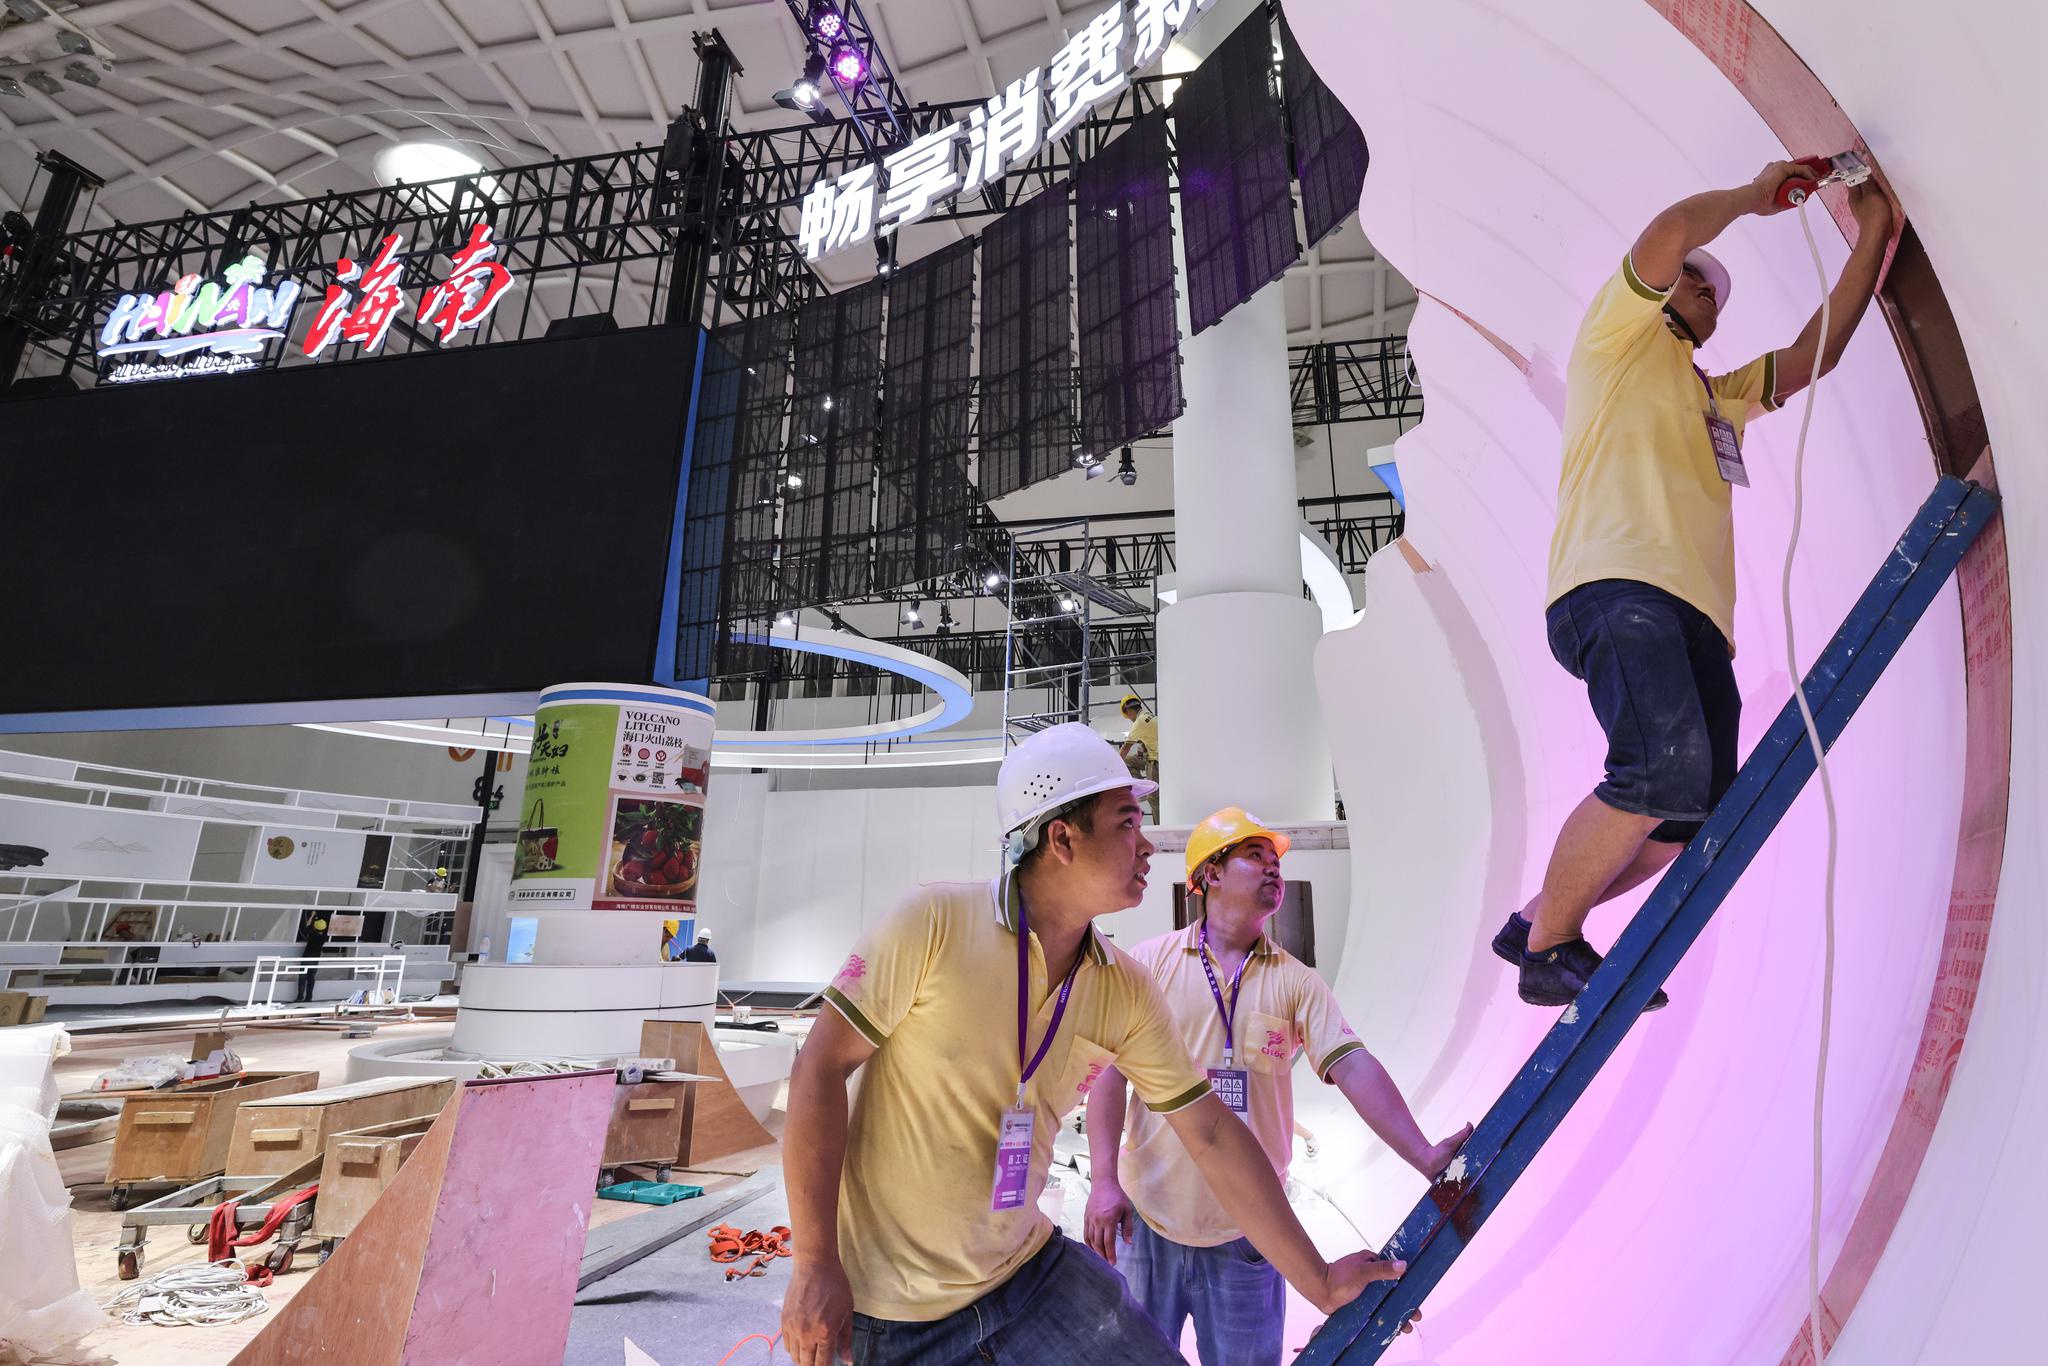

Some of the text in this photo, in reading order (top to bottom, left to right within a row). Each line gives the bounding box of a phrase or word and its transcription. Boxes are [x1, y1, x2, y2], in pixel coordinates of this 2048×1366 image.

[304, 223, 515, 358] 海南
[626, 711, 681, 726] VOLCANO
[625, 721, 666, 733] LITCHI
[623, 731, 683, 748] 海口火山荔枝
